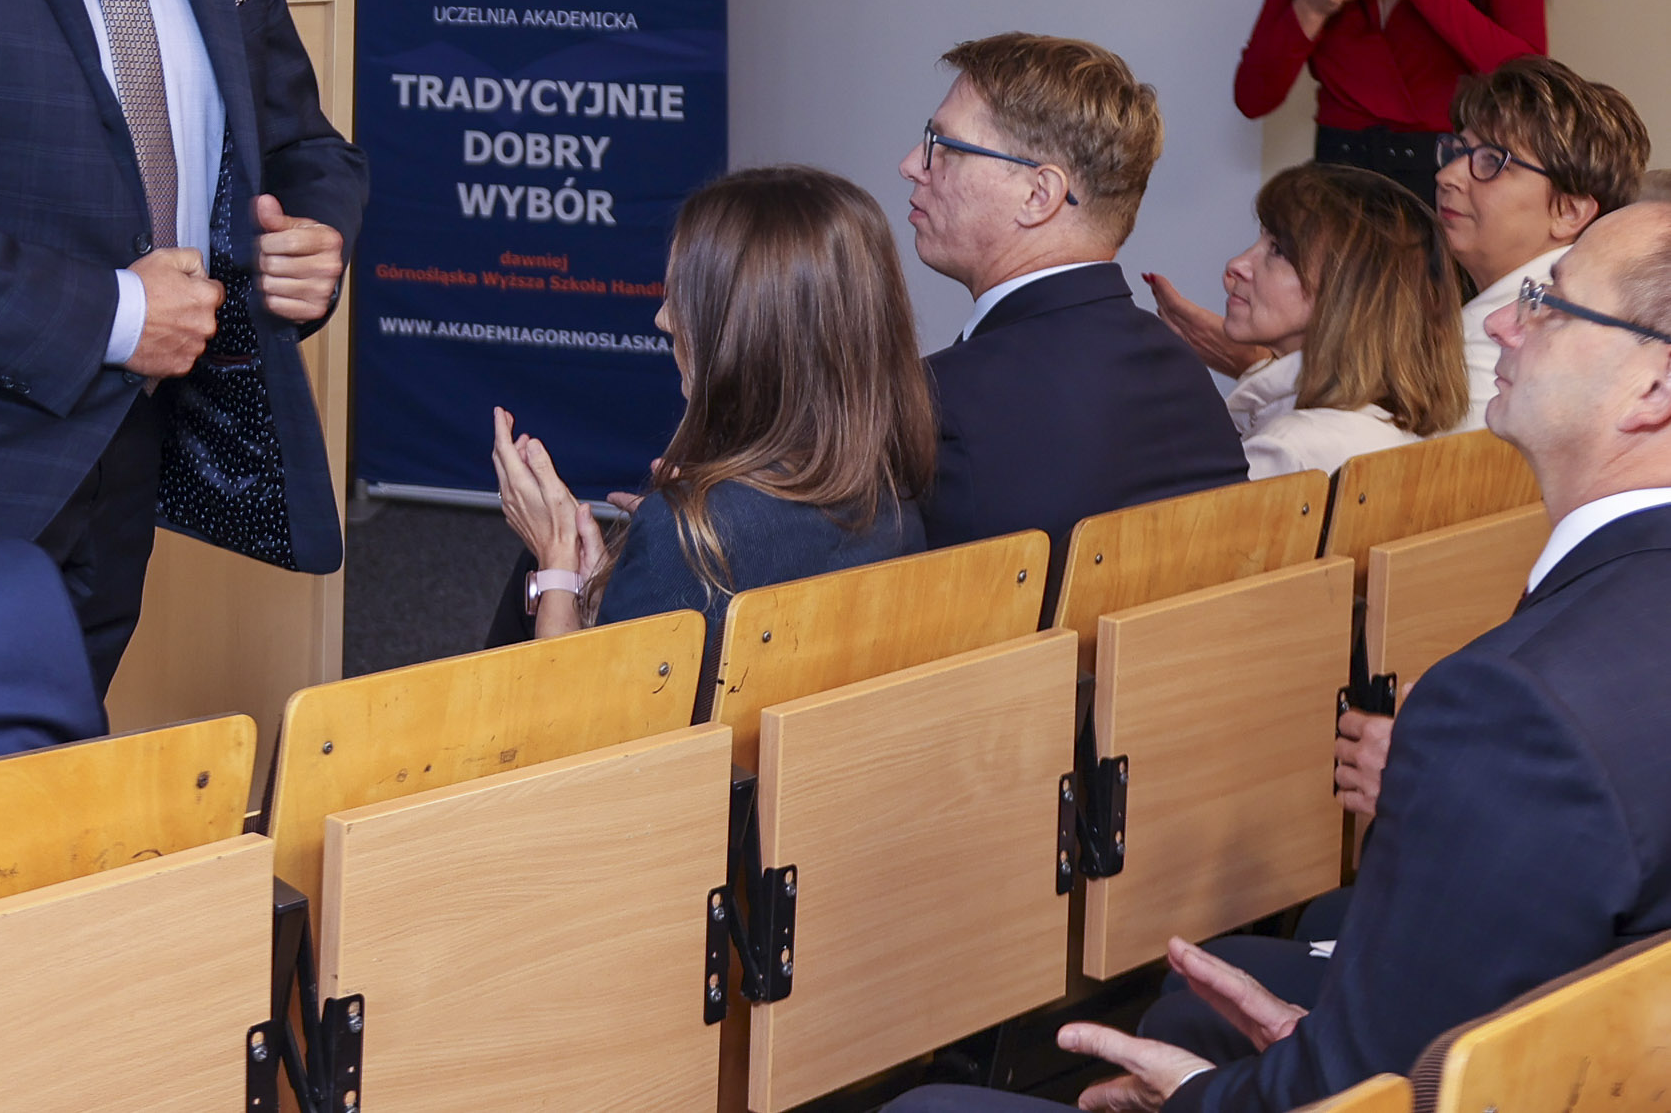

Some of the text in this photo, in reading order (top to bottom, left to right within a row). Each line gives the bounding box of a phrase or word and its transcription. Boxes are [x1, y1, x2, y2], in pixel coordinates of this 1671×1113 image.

[434, 6, 638, 30] UCZELNIA AKADEMICKA
[391, 73, 685, 120] TRADYCYJNIE
[463, 129, 610, 169] DOBRY
[457, 177, 617, 225] WYBÓR
[499, 250, 569, 272] dawniej
[376, 263, 665, 297] Górnośląska Wyższa Szkoła Handl
